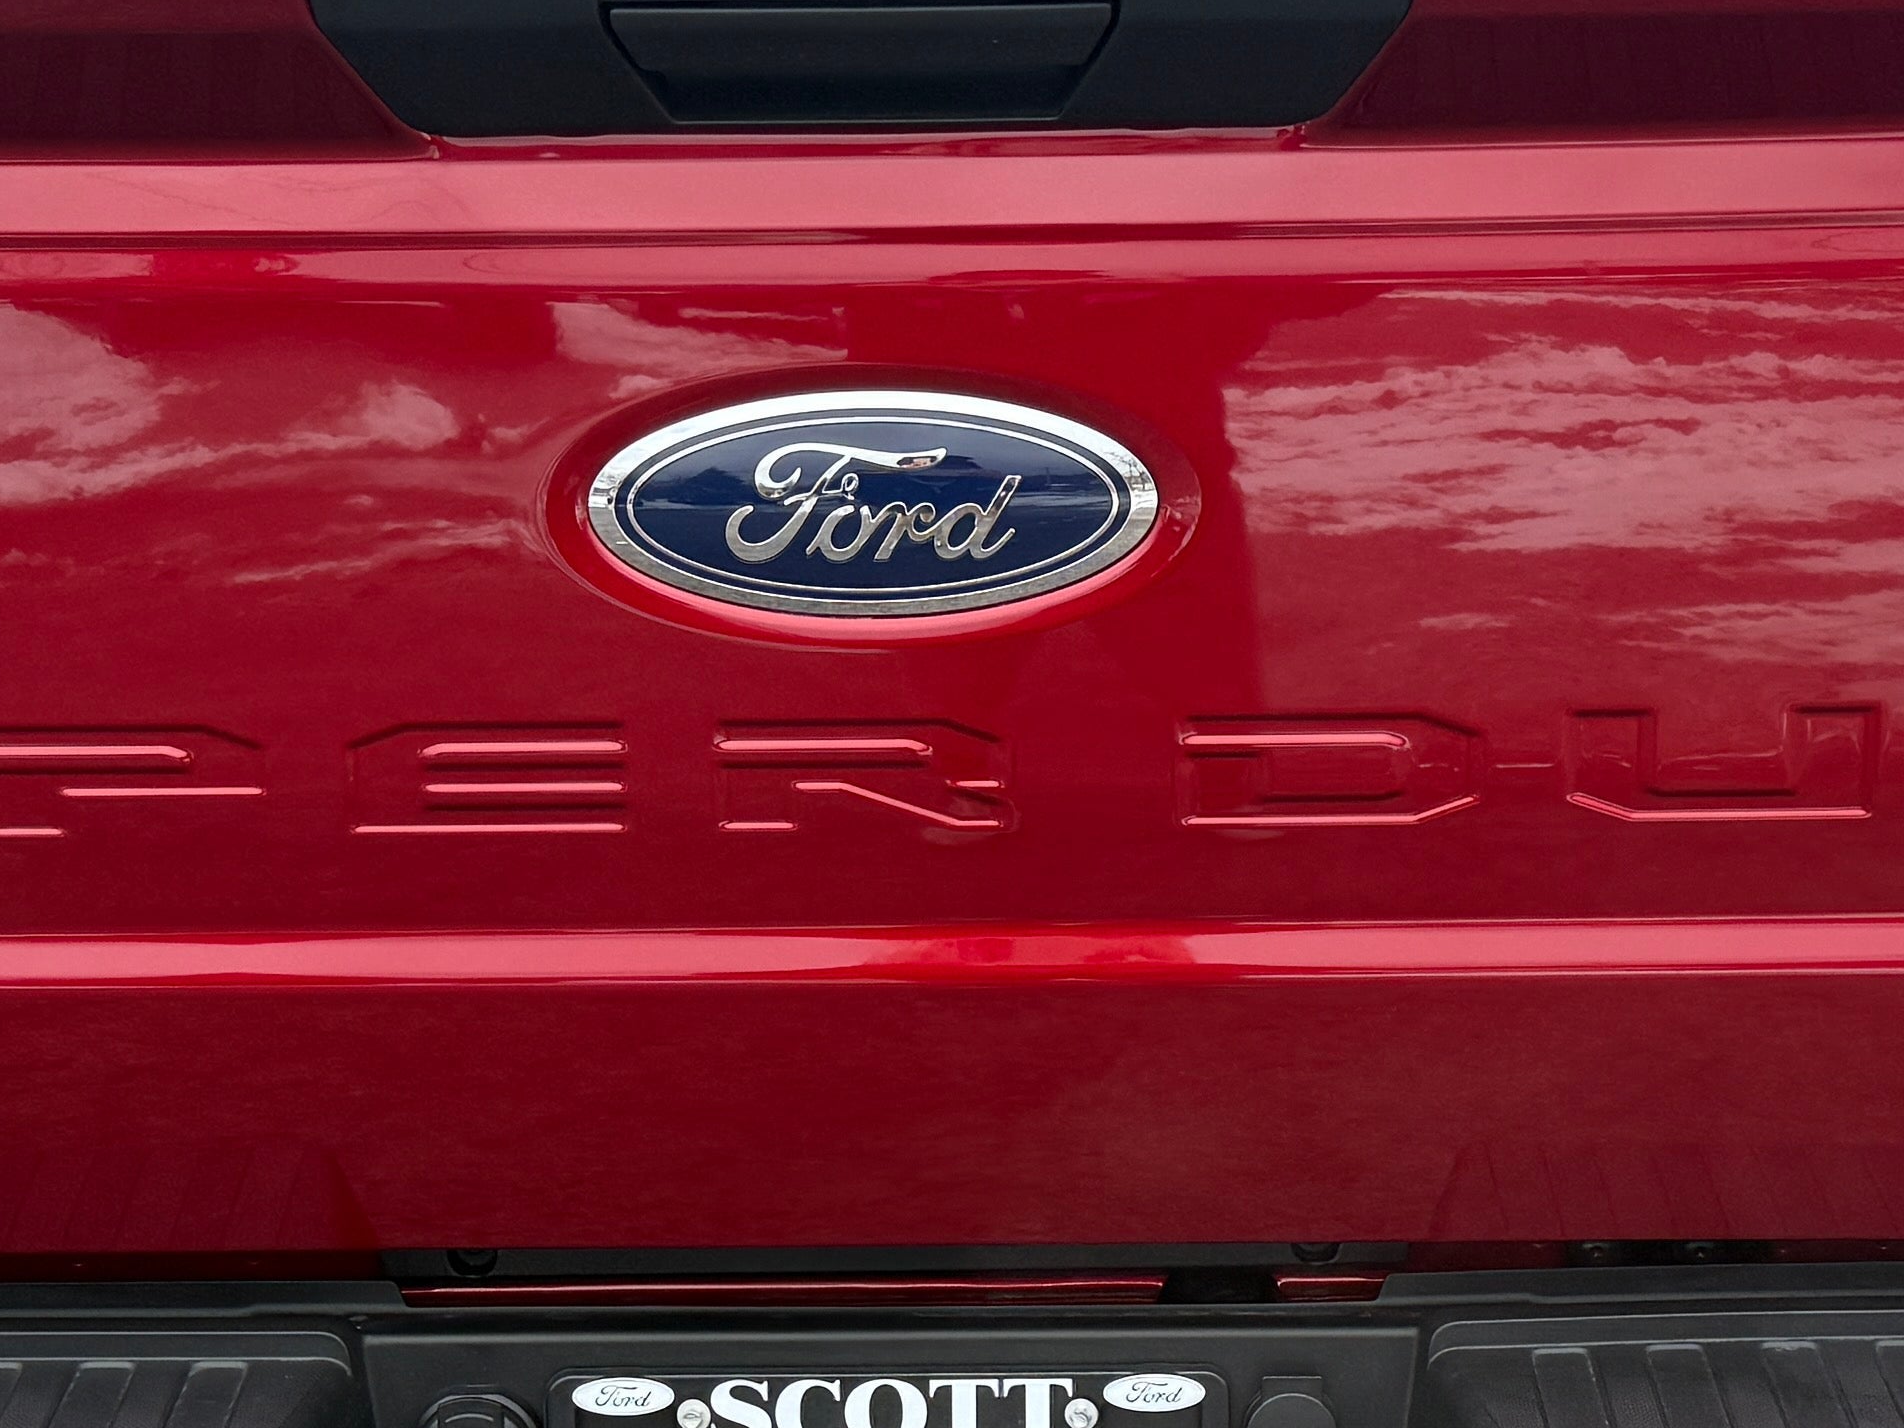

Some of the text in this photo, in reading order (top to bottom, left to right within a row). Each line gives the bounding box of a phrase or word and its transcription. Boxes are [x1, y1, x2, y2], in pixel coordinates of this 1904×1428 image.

[723, 441, 1023, 564] Ford
[594, 1384, 652, 1408] Ford
[1125, 1380, 1184, 1404] Ford
